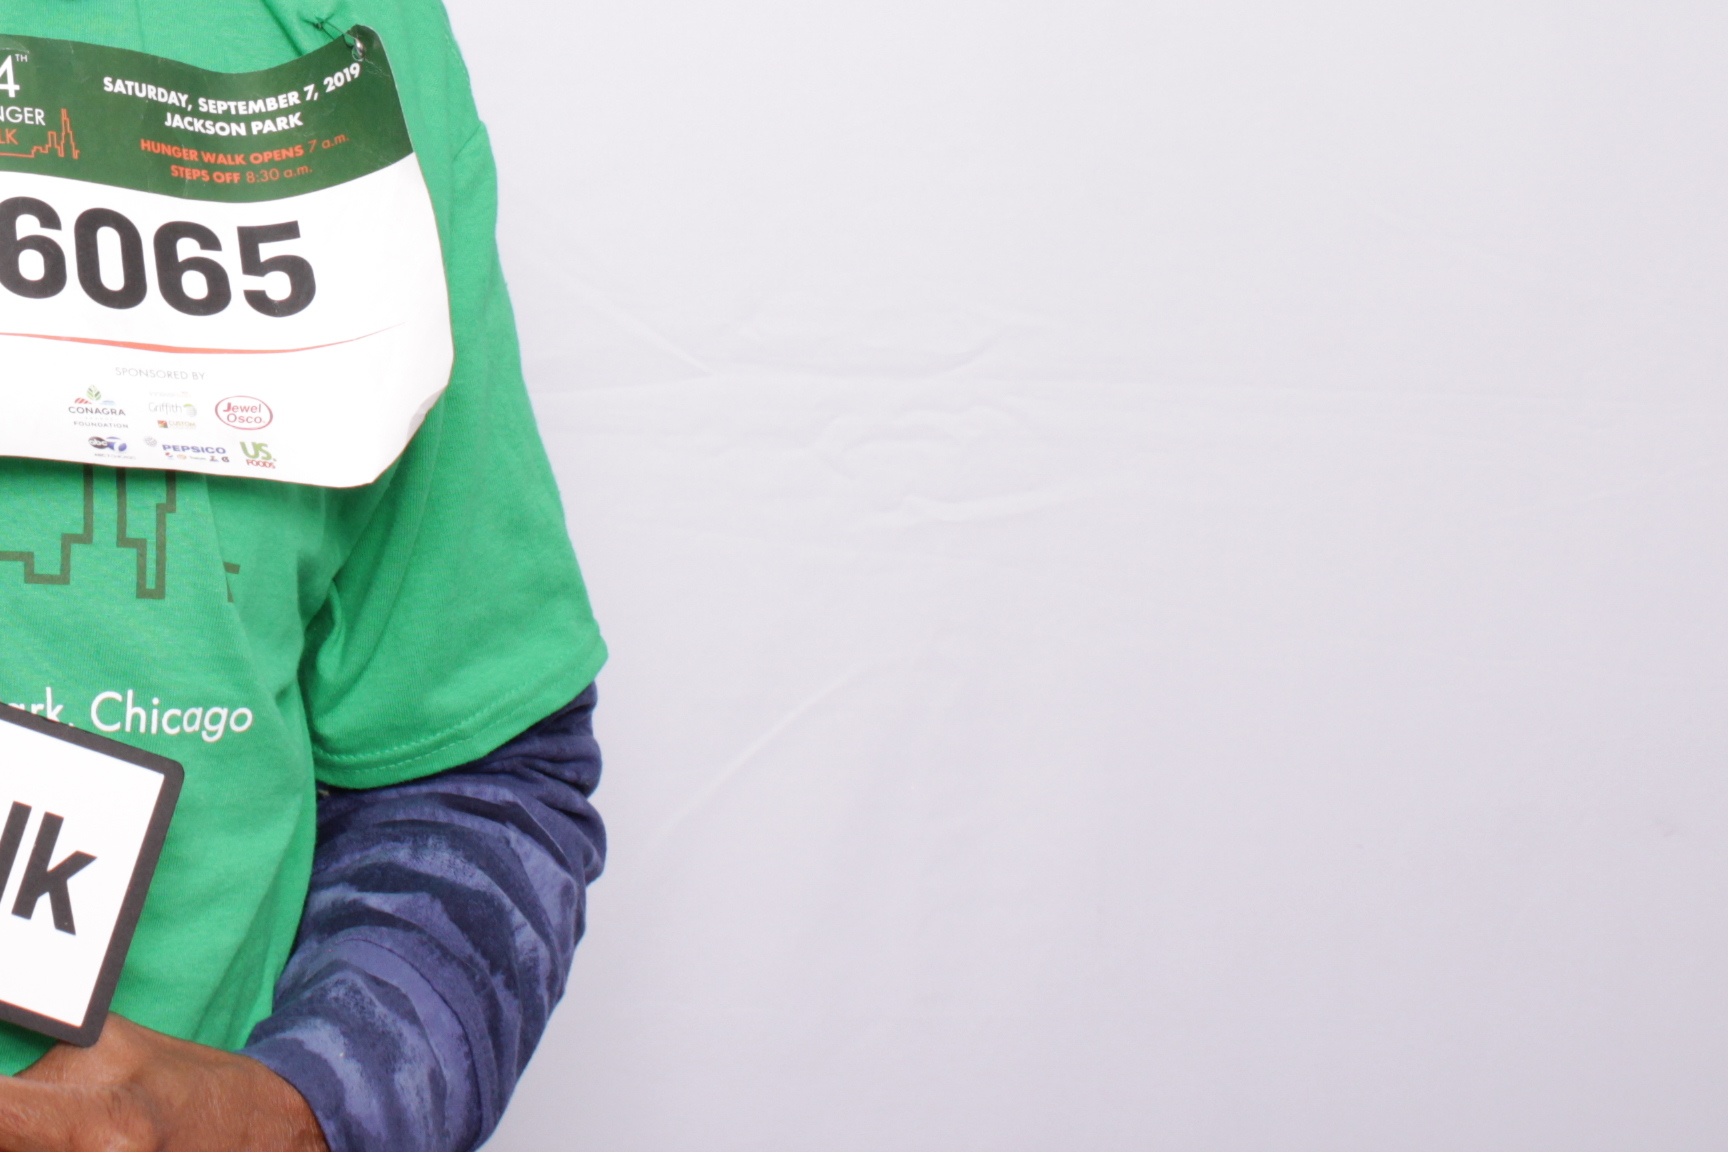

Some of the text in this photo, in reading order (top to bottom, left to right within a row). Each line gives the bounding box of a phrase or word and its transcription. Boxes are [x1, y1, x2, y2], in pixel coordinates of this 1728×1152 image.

[102, 62, 362, 115] SATURDAY, SEPTEMBER 7, 2019
[164, 112, 304, 137] JACKSON PARK
[139, 133, 350, 166] HUNGER WALK OPENS 7 a.m.
[170, 164, 313, 184] STEPS OFF 8:30 a.m.
[114, 366, 189, 380] SPONSORED
[68, 406, 126, 416] CONAGRA
[148, 401, 183, 415] Griffith
[222, 402, 262, 413] Jewel
[73, 420, 129, 429] FOUNDATION
[162, 444, 227, 454] PEPSICO
[245, 459, 276, 469] FOODS
[90, 689, 253, 743] Chicago
